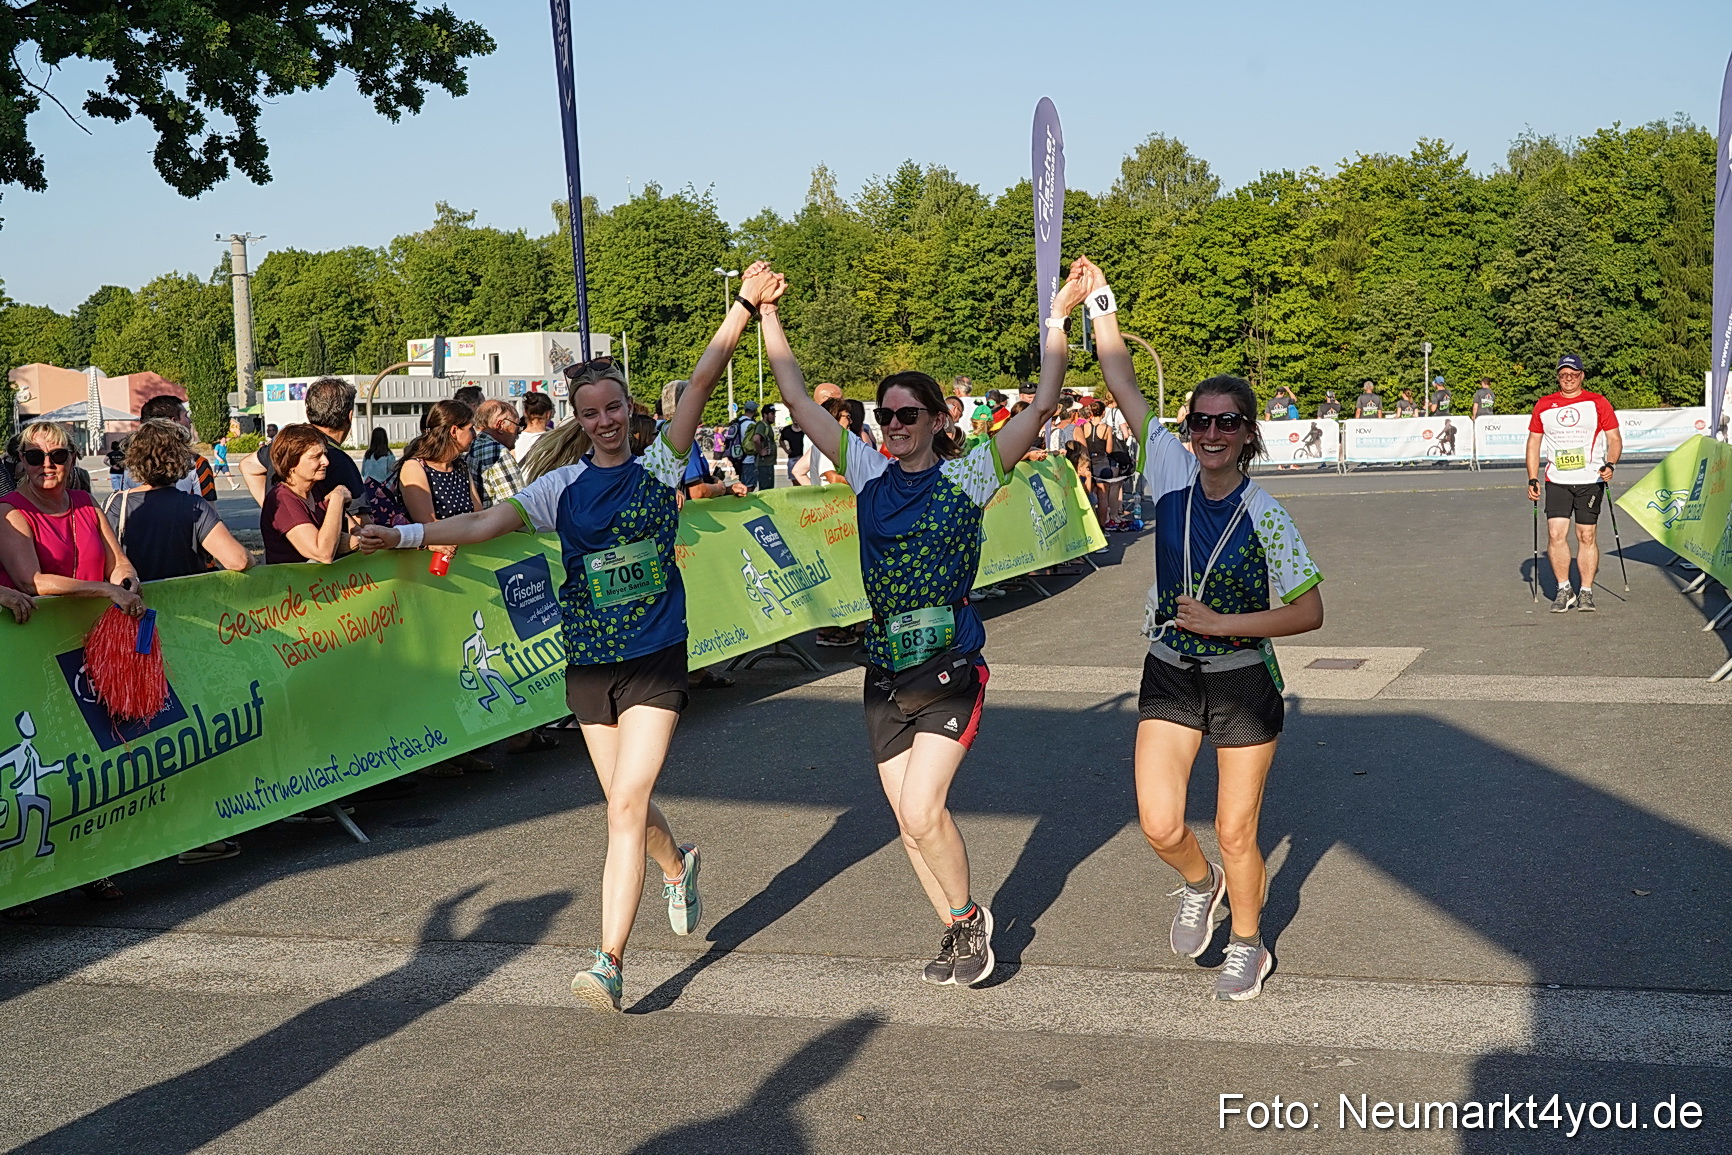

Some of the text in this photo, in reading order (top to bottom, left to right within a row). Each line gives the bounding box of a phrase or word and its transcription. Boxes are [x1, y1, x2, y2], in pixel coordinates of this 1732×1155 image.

[1043, 124, 1052, 223] Fischer
[1560, 455, 1580, 464] 1501
[604, 562, 644, 587] 706
[650, 560, 661, 586] 2022
[513, 580, 545, 602] Fischer
[592, 578, 602, 598] RUN
[218, 572, 379, 645] Gesunde Firmen
[272, 591, 404, 669] laufen länger!
[901, 627, 938, 649] 683
[891, 642, 900, 660] RUN
[66, 680, 264, 815] firmenlauf
[215, 725, 447, 819] www.firmenlauf-oberpfalz.de
[69, 783, 167, 841] neumarkt
